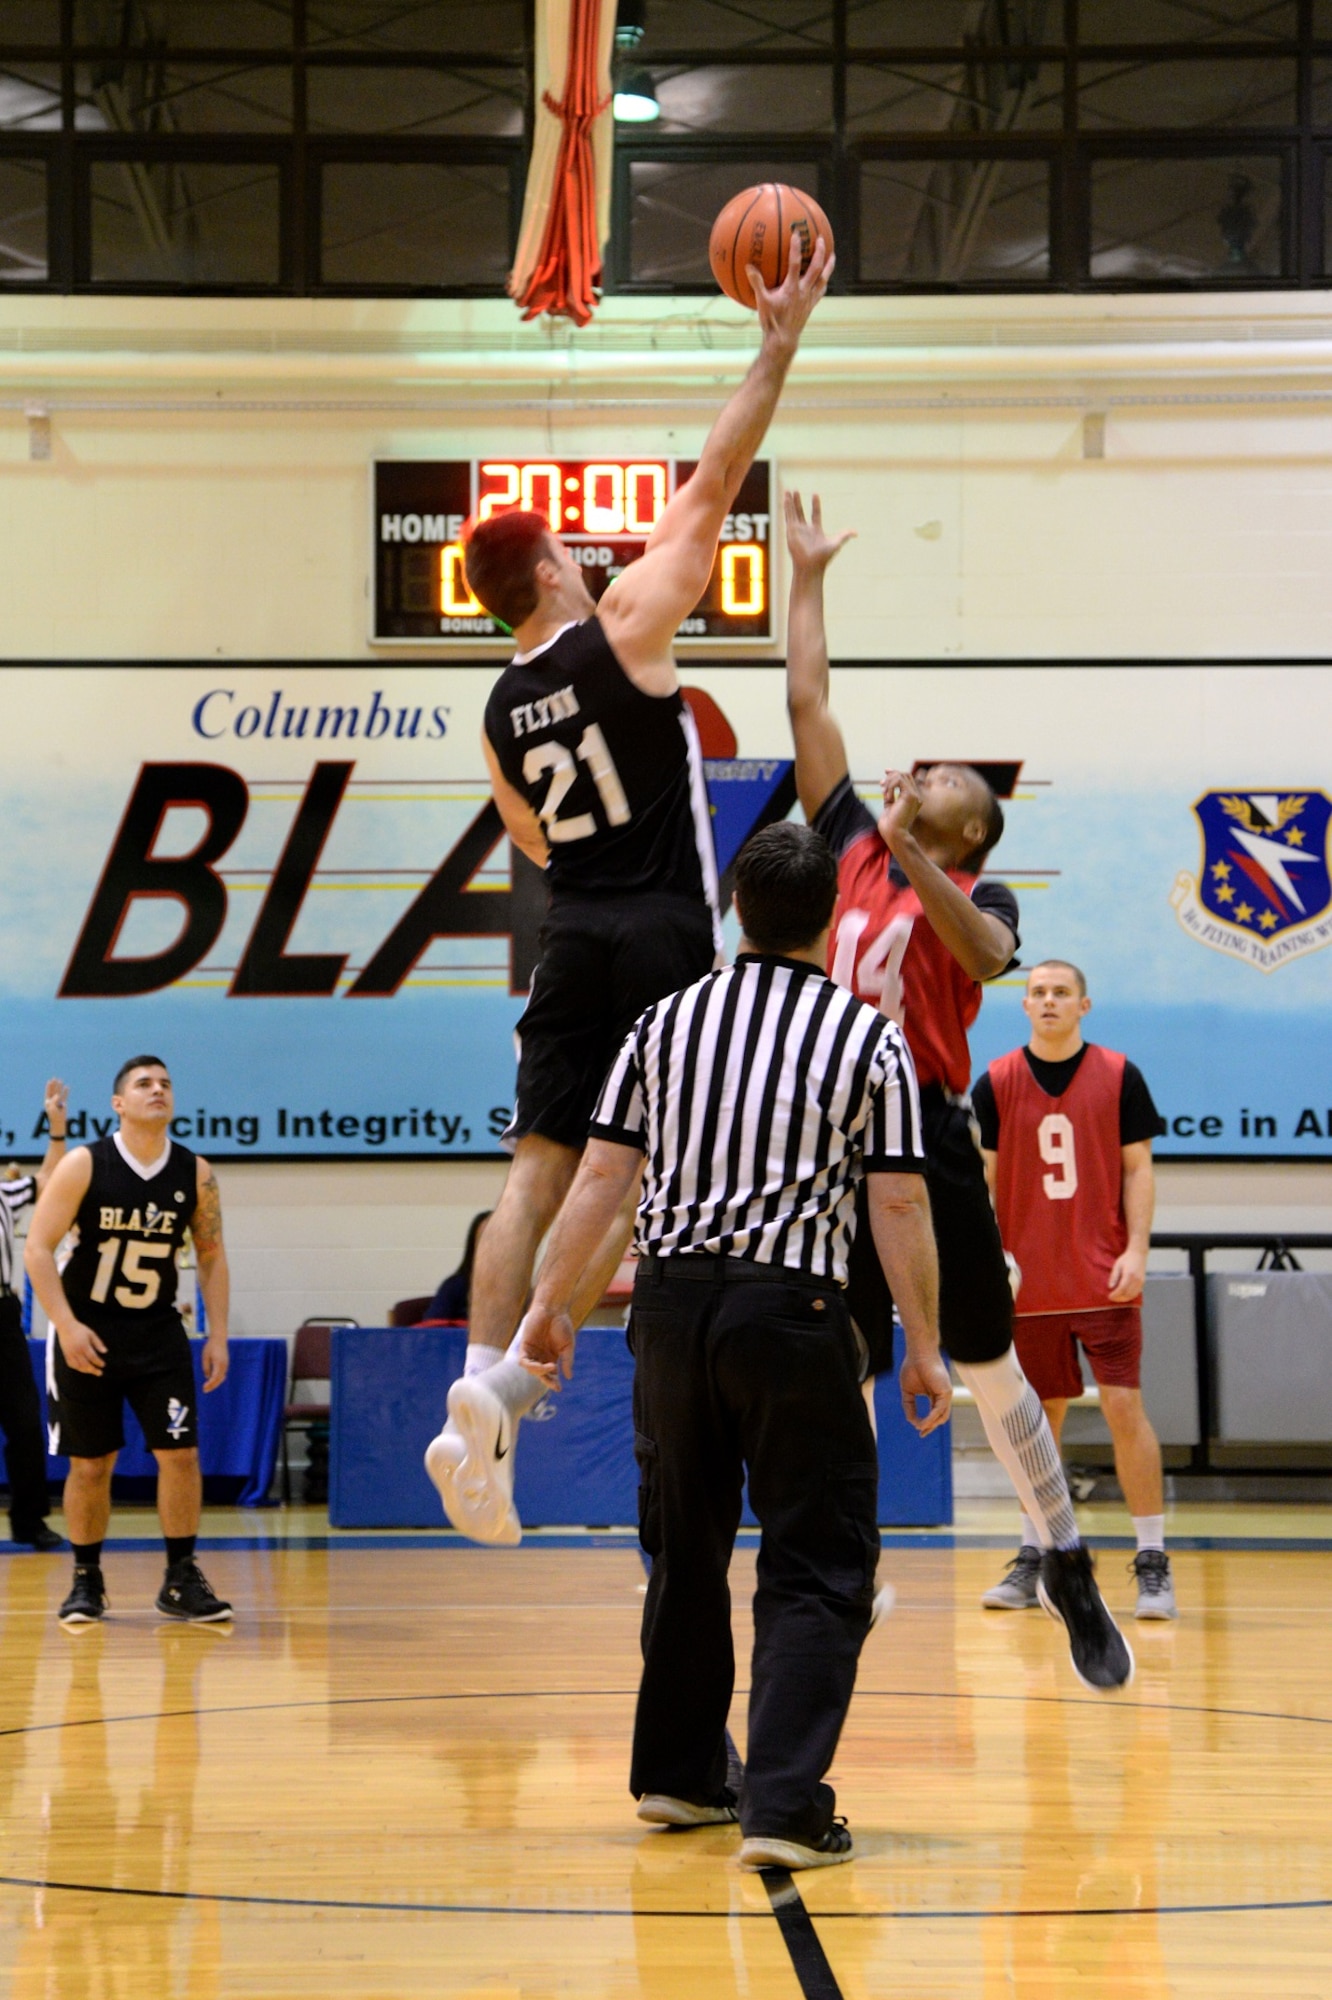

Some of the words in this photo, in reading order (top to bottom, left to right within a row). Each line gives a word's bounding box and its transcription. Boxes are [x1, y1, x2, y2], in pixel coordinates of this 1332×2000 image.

[381, 514, 464, 543] HOME
[479, 464, 666, 533] 20:00
[719, 513, 769, 542] EST
[440, 545, 482, 616] 0
[722, 545, 763, 615] 0
[440, 617, 495, 633] BONUS
[191, 688, 451, 741] Columbus
[522, 722, 631, 843] 21
[831, 908, 915, 1028] 14
[1202, 921, 1247, 953] FLYING
[1251, 932, 1315, 965] TRAINING
[277, 1108, 471, 1145] Integrity,
[1241, 1109, 1277, 1138] in
[1036, 1113, 1078, 1200] 9
[90, 1237, 172, 1309] 15
